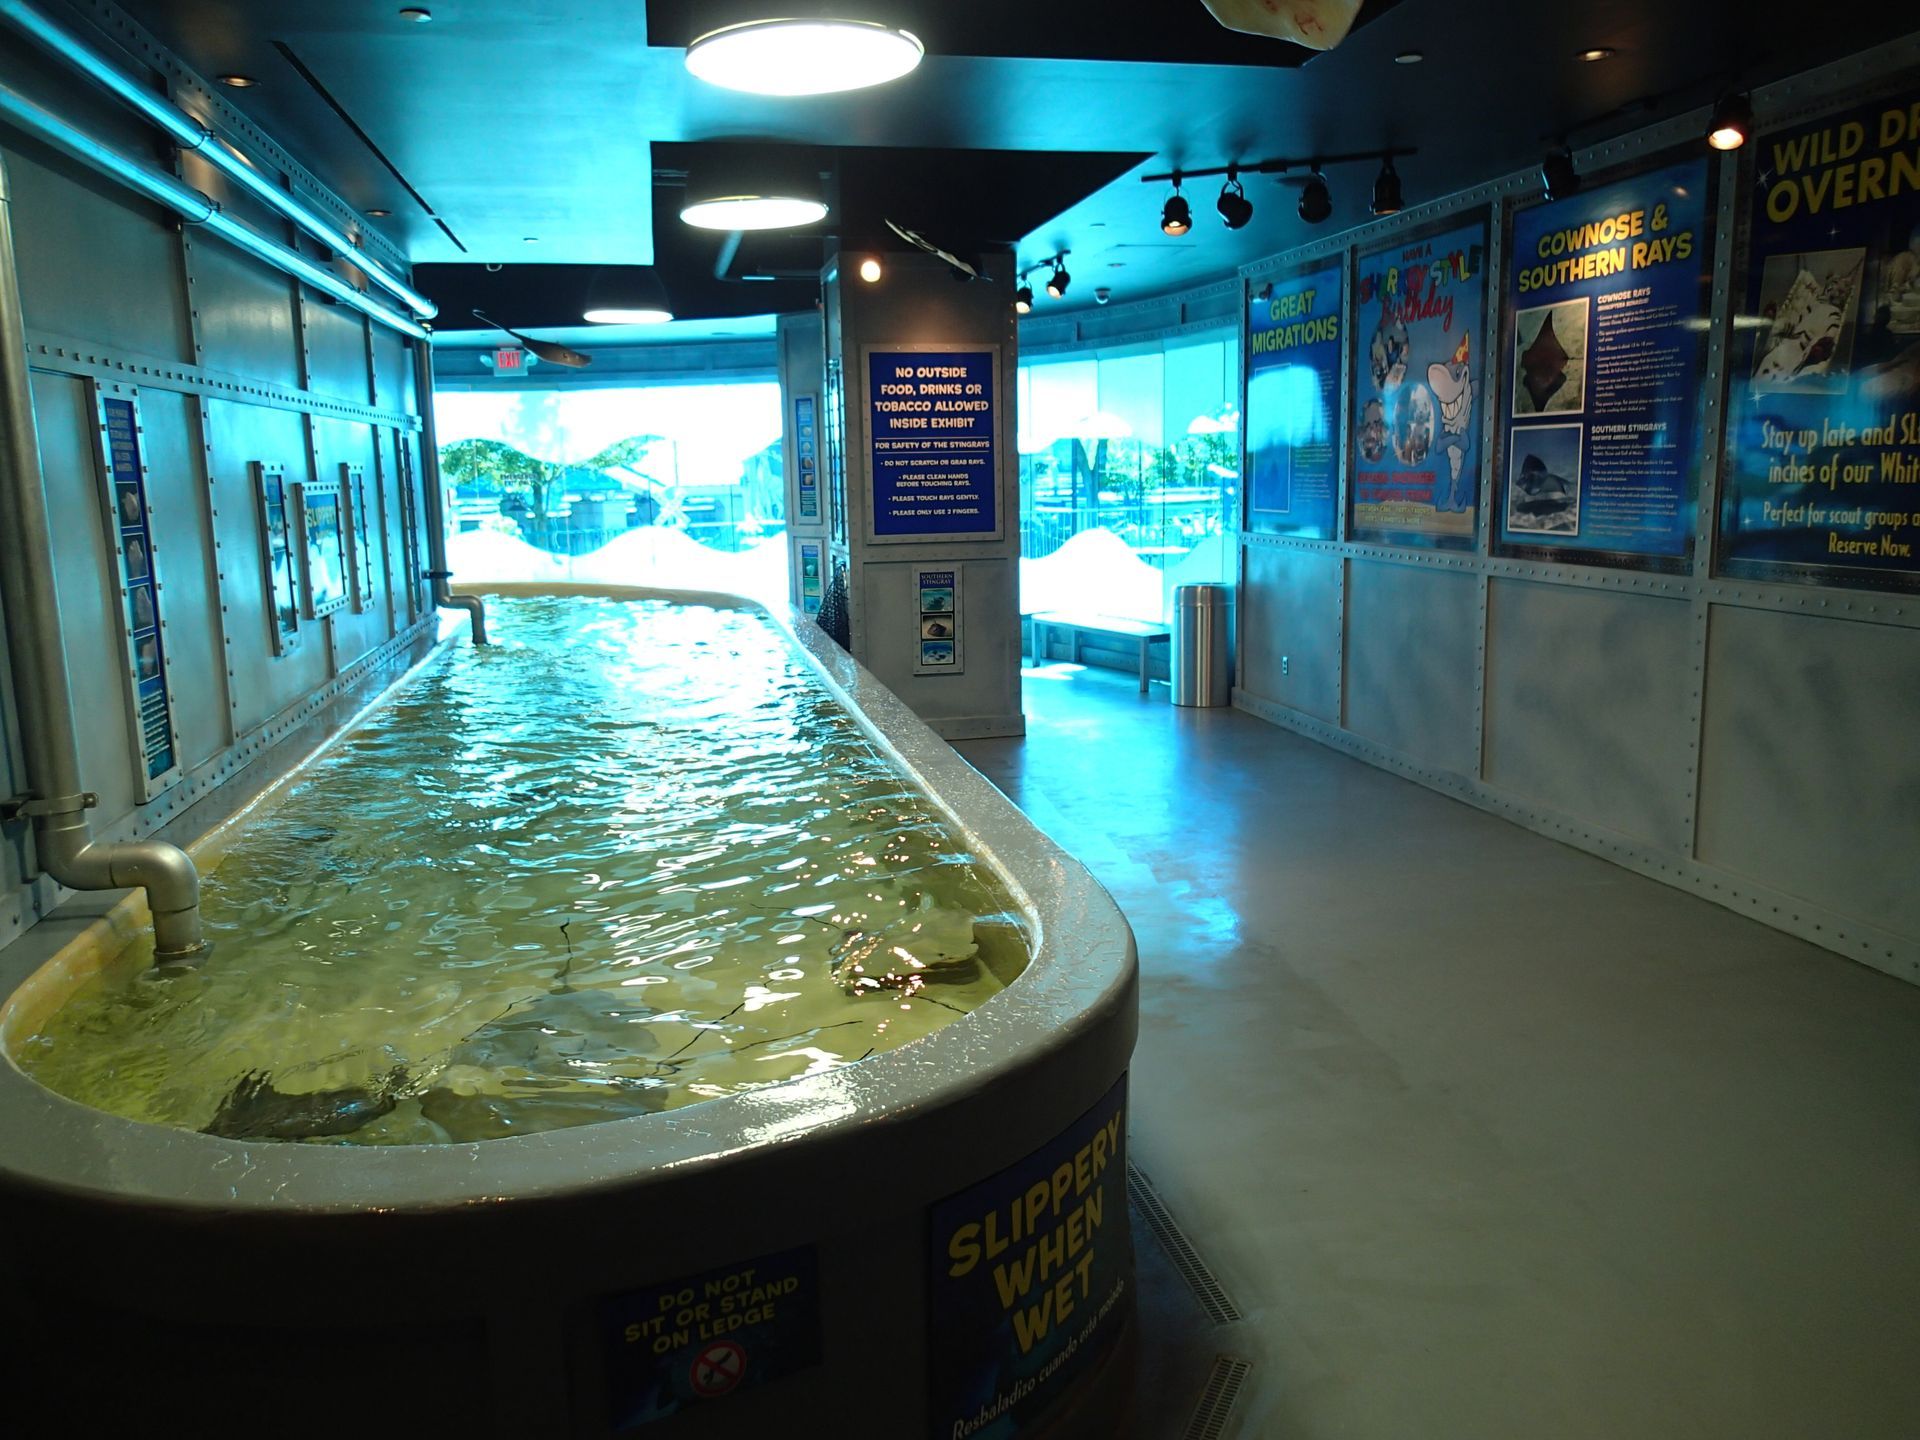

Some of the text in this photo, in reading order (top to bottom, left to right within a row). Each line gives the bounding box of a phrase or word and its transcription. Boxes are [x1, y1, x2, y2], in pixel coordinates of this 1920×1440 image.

[1771, 120, 1865, 177] WILD
[1537, 203, 1668, 260] COWNOSE &
[1430, 245, 1482, 287] STYLE
[1518, 232, 1693, 293] SOUTHERN RAYS
[1270, 290, 1316, 321] GREAT
[1597, 287, 1651, 304] COWNOSE RAYS
[1252, 316, 1338, 355] MIGRATIONS
[497, 351, 520, 368] EXIT
[895, 367, 967, 378] NO OUTSIDE
[874, 400, 989, 412] TOBACCO ALLOWED
[881, 384, 982, 396] FOOD, DRINKS OR
[889, 417, 975, 429] INSIDE EXHIBIT
[1591, 422, 1667, 434] SOUTHERN STINGRAYS
[1761, 420, 1794, 456] Stay
[1798, 430, 1818, 455] up
[1822, 417, 1856, 447] late
[1861, 413, 1896, 446] and
[875, 442, 890, 450] FOR
[921, 441, 932, 449] OF
[949, 441, 990, 449] STINGRAYS
[1768, 454, 1816, 484] inches
[1819, 453, 1840, 491] of
[1842, 465, 1874, 483] our
[1763, 501, 1804, 528] Perfect
[1808, 502, 1826, 528] for
[1829, 507, 1862, 524] scout
[1864, 511, 1908, 531] groups
[1828, 531, 1911, 558] Reserve Now.
[947, 1110, 1121, 1279] SLIPPERY
[992, 1183, 1104, 1311] WHEN
[624, 1275, 800, 1345] SIT OR STAND
[658, 1268, 757, 1313] DO NOT
[1012, 1247, 1095, 1356] WET
[651, 1302, 776, 1356] ON LEDGE
[952, 1377, 1036, 1440] Resbaladizo
[1039, 1335, 1078, 1382] cuando
